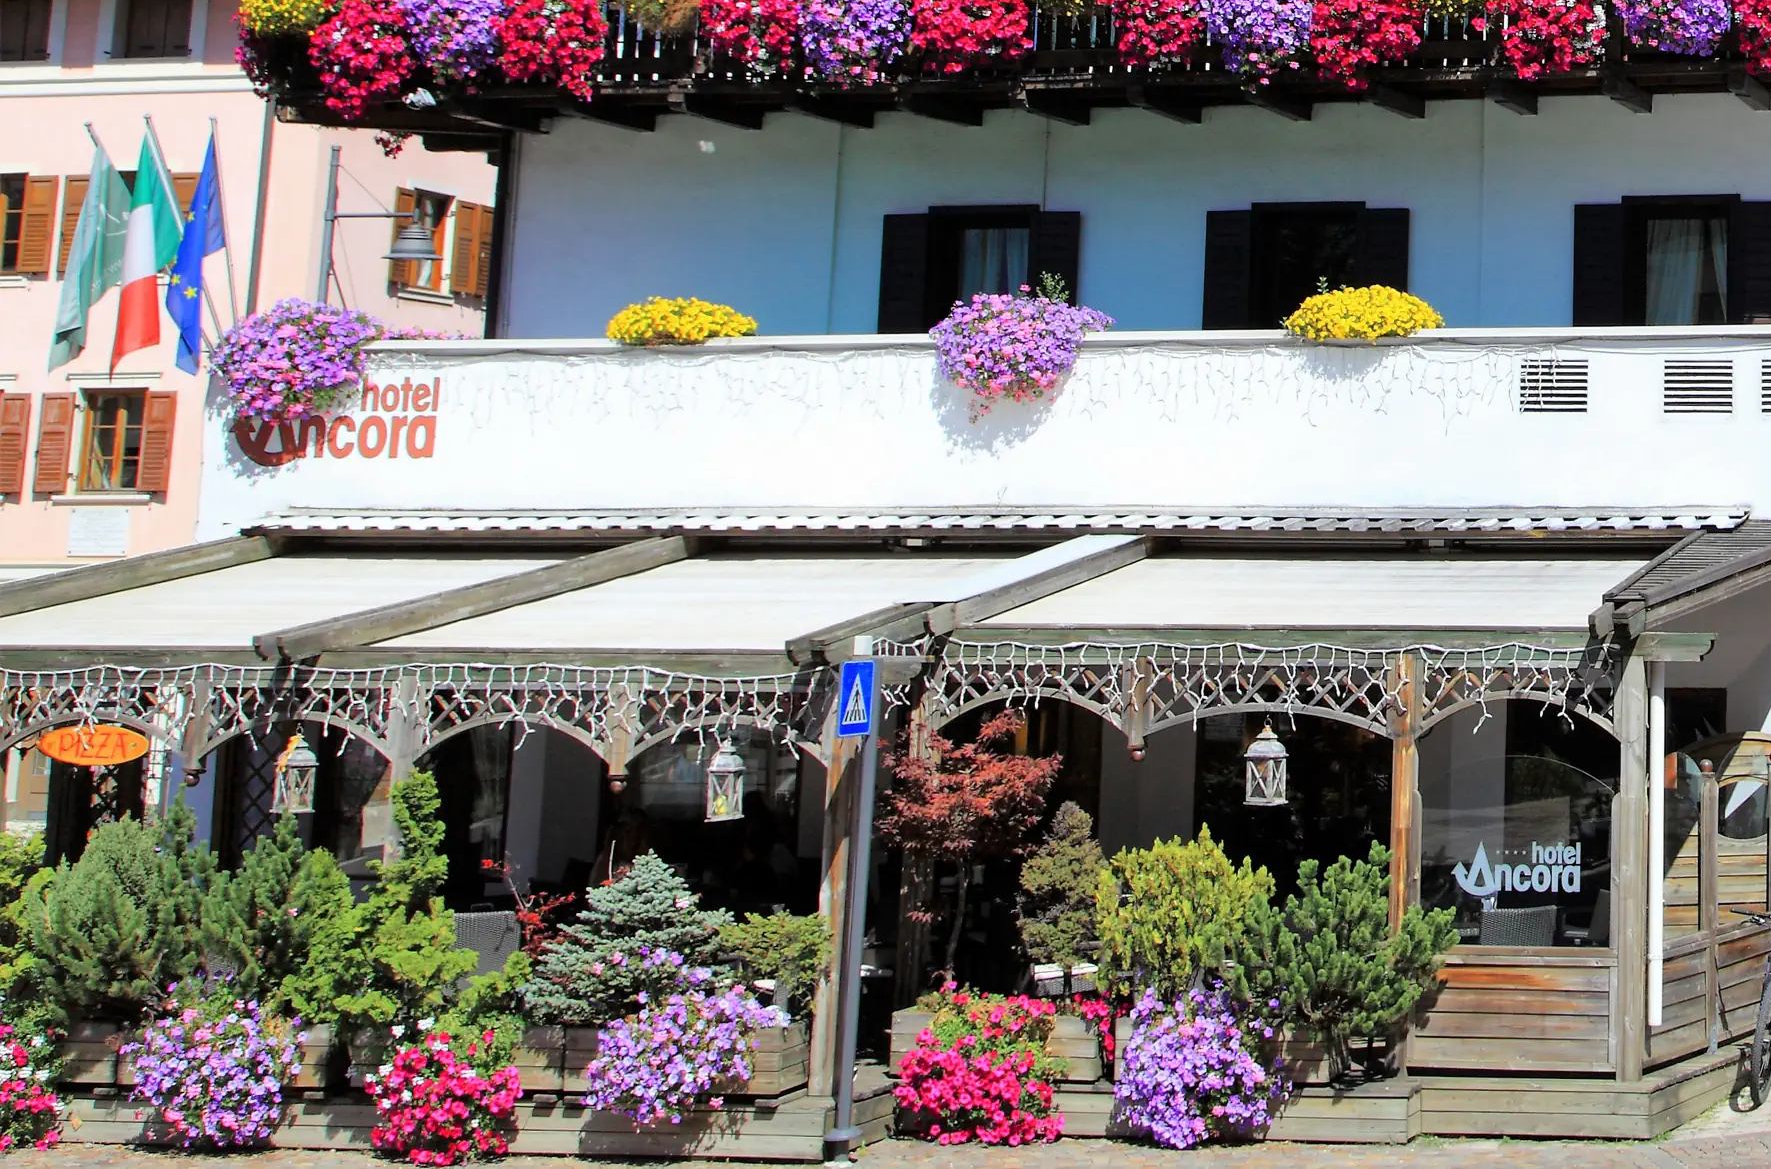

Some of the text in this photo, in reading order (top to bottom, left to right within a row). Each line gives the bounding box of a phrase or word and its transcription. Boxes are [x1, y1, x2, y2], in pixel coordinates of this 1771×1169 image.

[361, 377, 440, 412] hotel
[59, 733, 128, 759] PIZZA
[1451, 840, 1581, 896] Ancora
[1531, 841, 1581, 865] hotel
